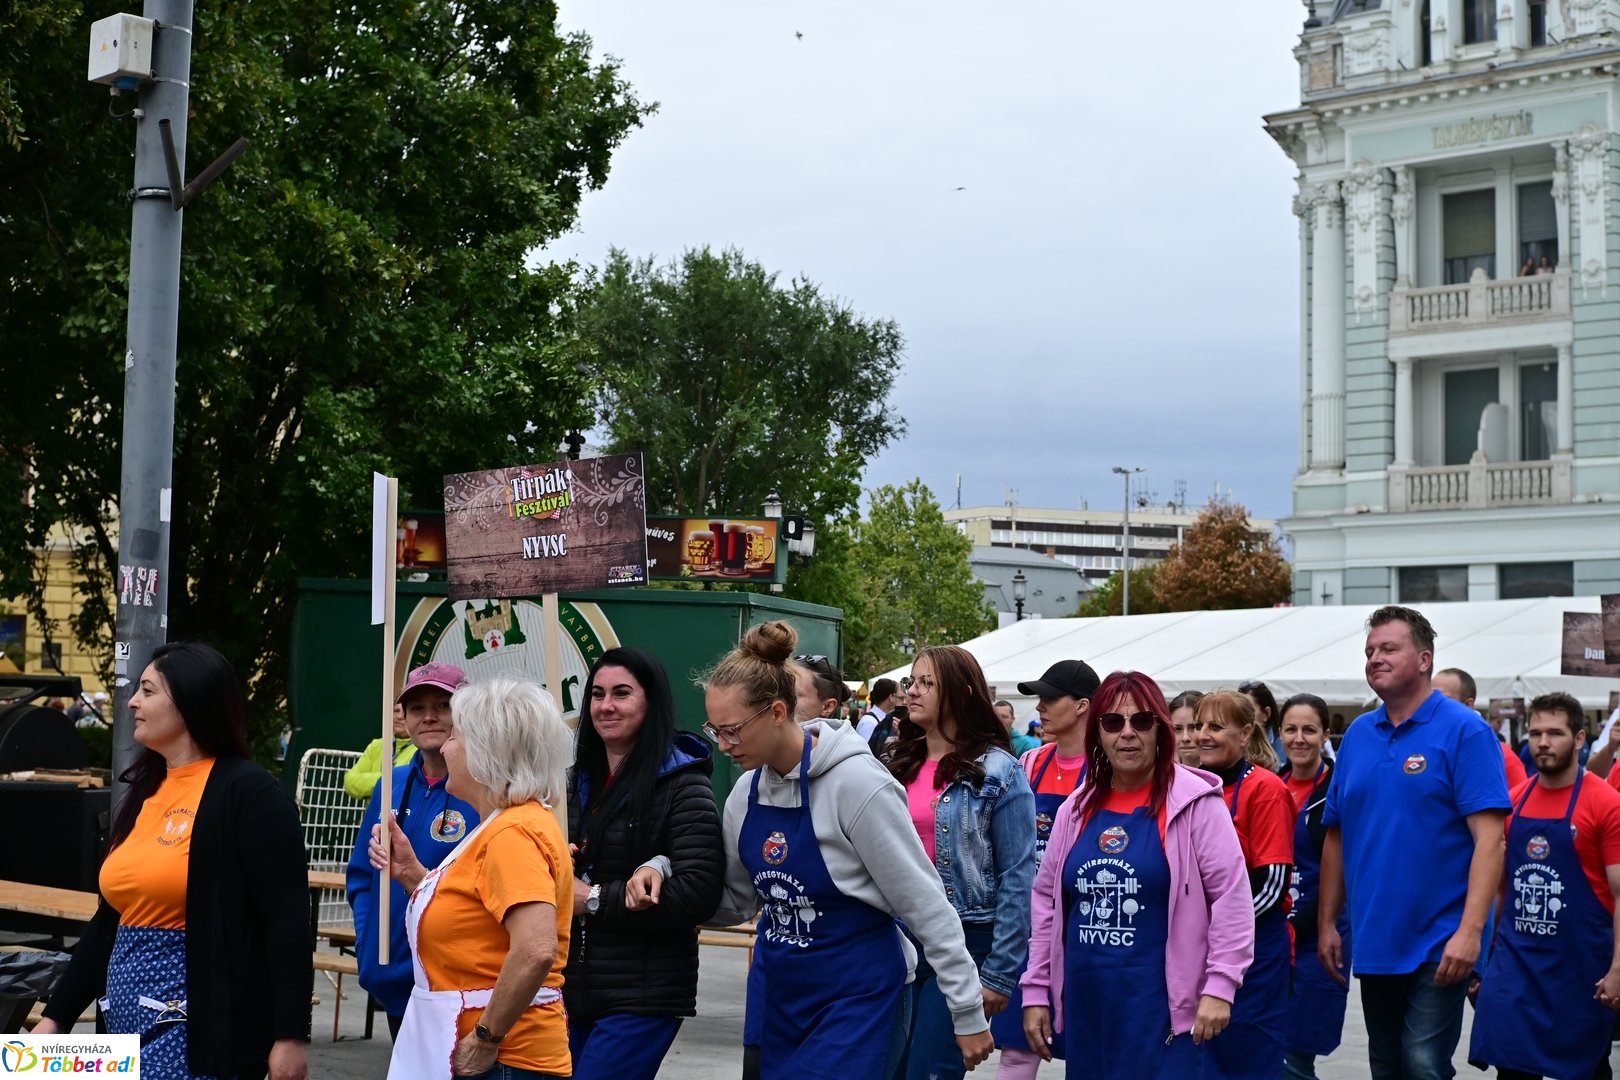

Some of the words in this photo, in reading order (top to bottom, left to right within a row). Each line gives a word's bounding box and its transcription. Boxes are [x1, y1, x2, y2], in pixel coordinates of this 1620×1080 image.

[510, 468, 567, 501] Tirpák
[515, 490, 570, 518] Fesztivál
[522, 533, 567, 559] NYVSC
[1077, 858, 1135, 876] NYÍREGYHÁZA
[753, 870, 805, 893] NYÍREGYHÁZA
[1079, 929, 1134, 947] NYVSC
[1514, 920, 1557, 936] NYVSC
